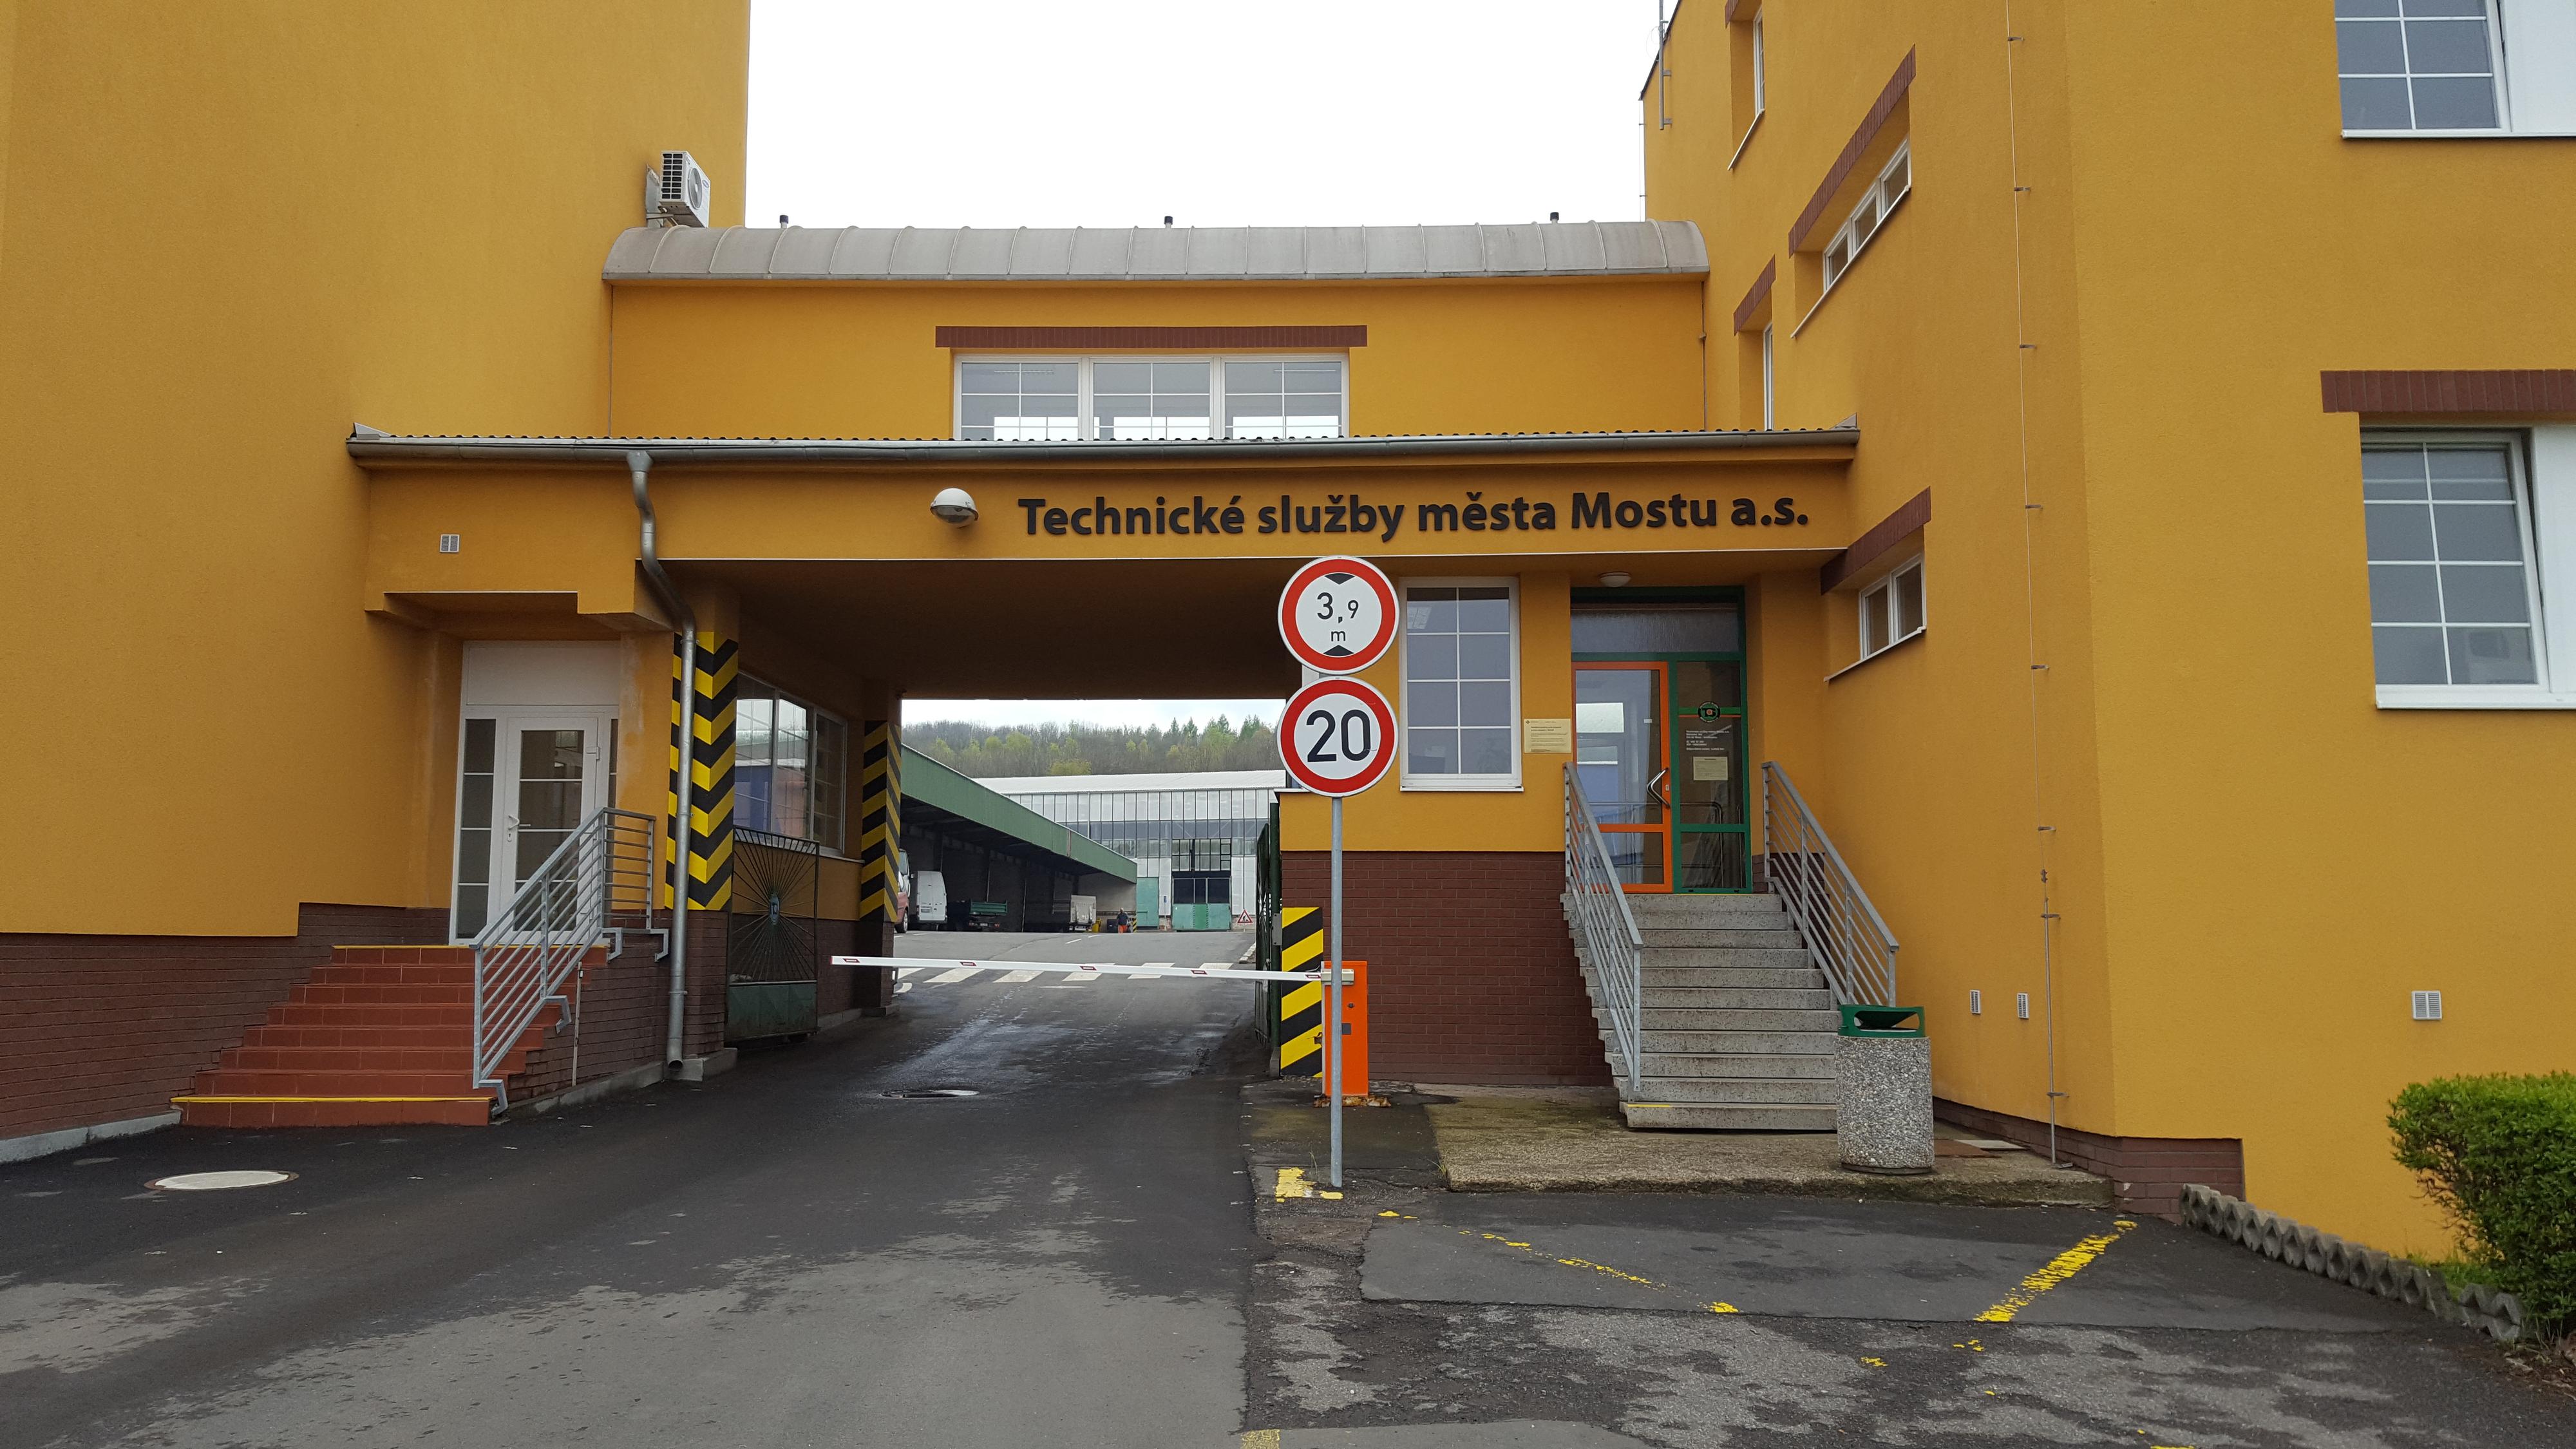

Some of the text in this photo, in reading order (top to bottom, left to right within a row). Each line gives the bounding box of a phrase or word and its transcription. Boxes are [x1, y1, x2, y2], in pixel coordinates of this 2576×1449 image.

[1018, 491, 1809, 544] Technické služby města Mostu a.s.
[1316, 591, 1359, 625] 3,9
[1331, 630, 1347, 642] m
[1305, 709, 1372, 762] 20
